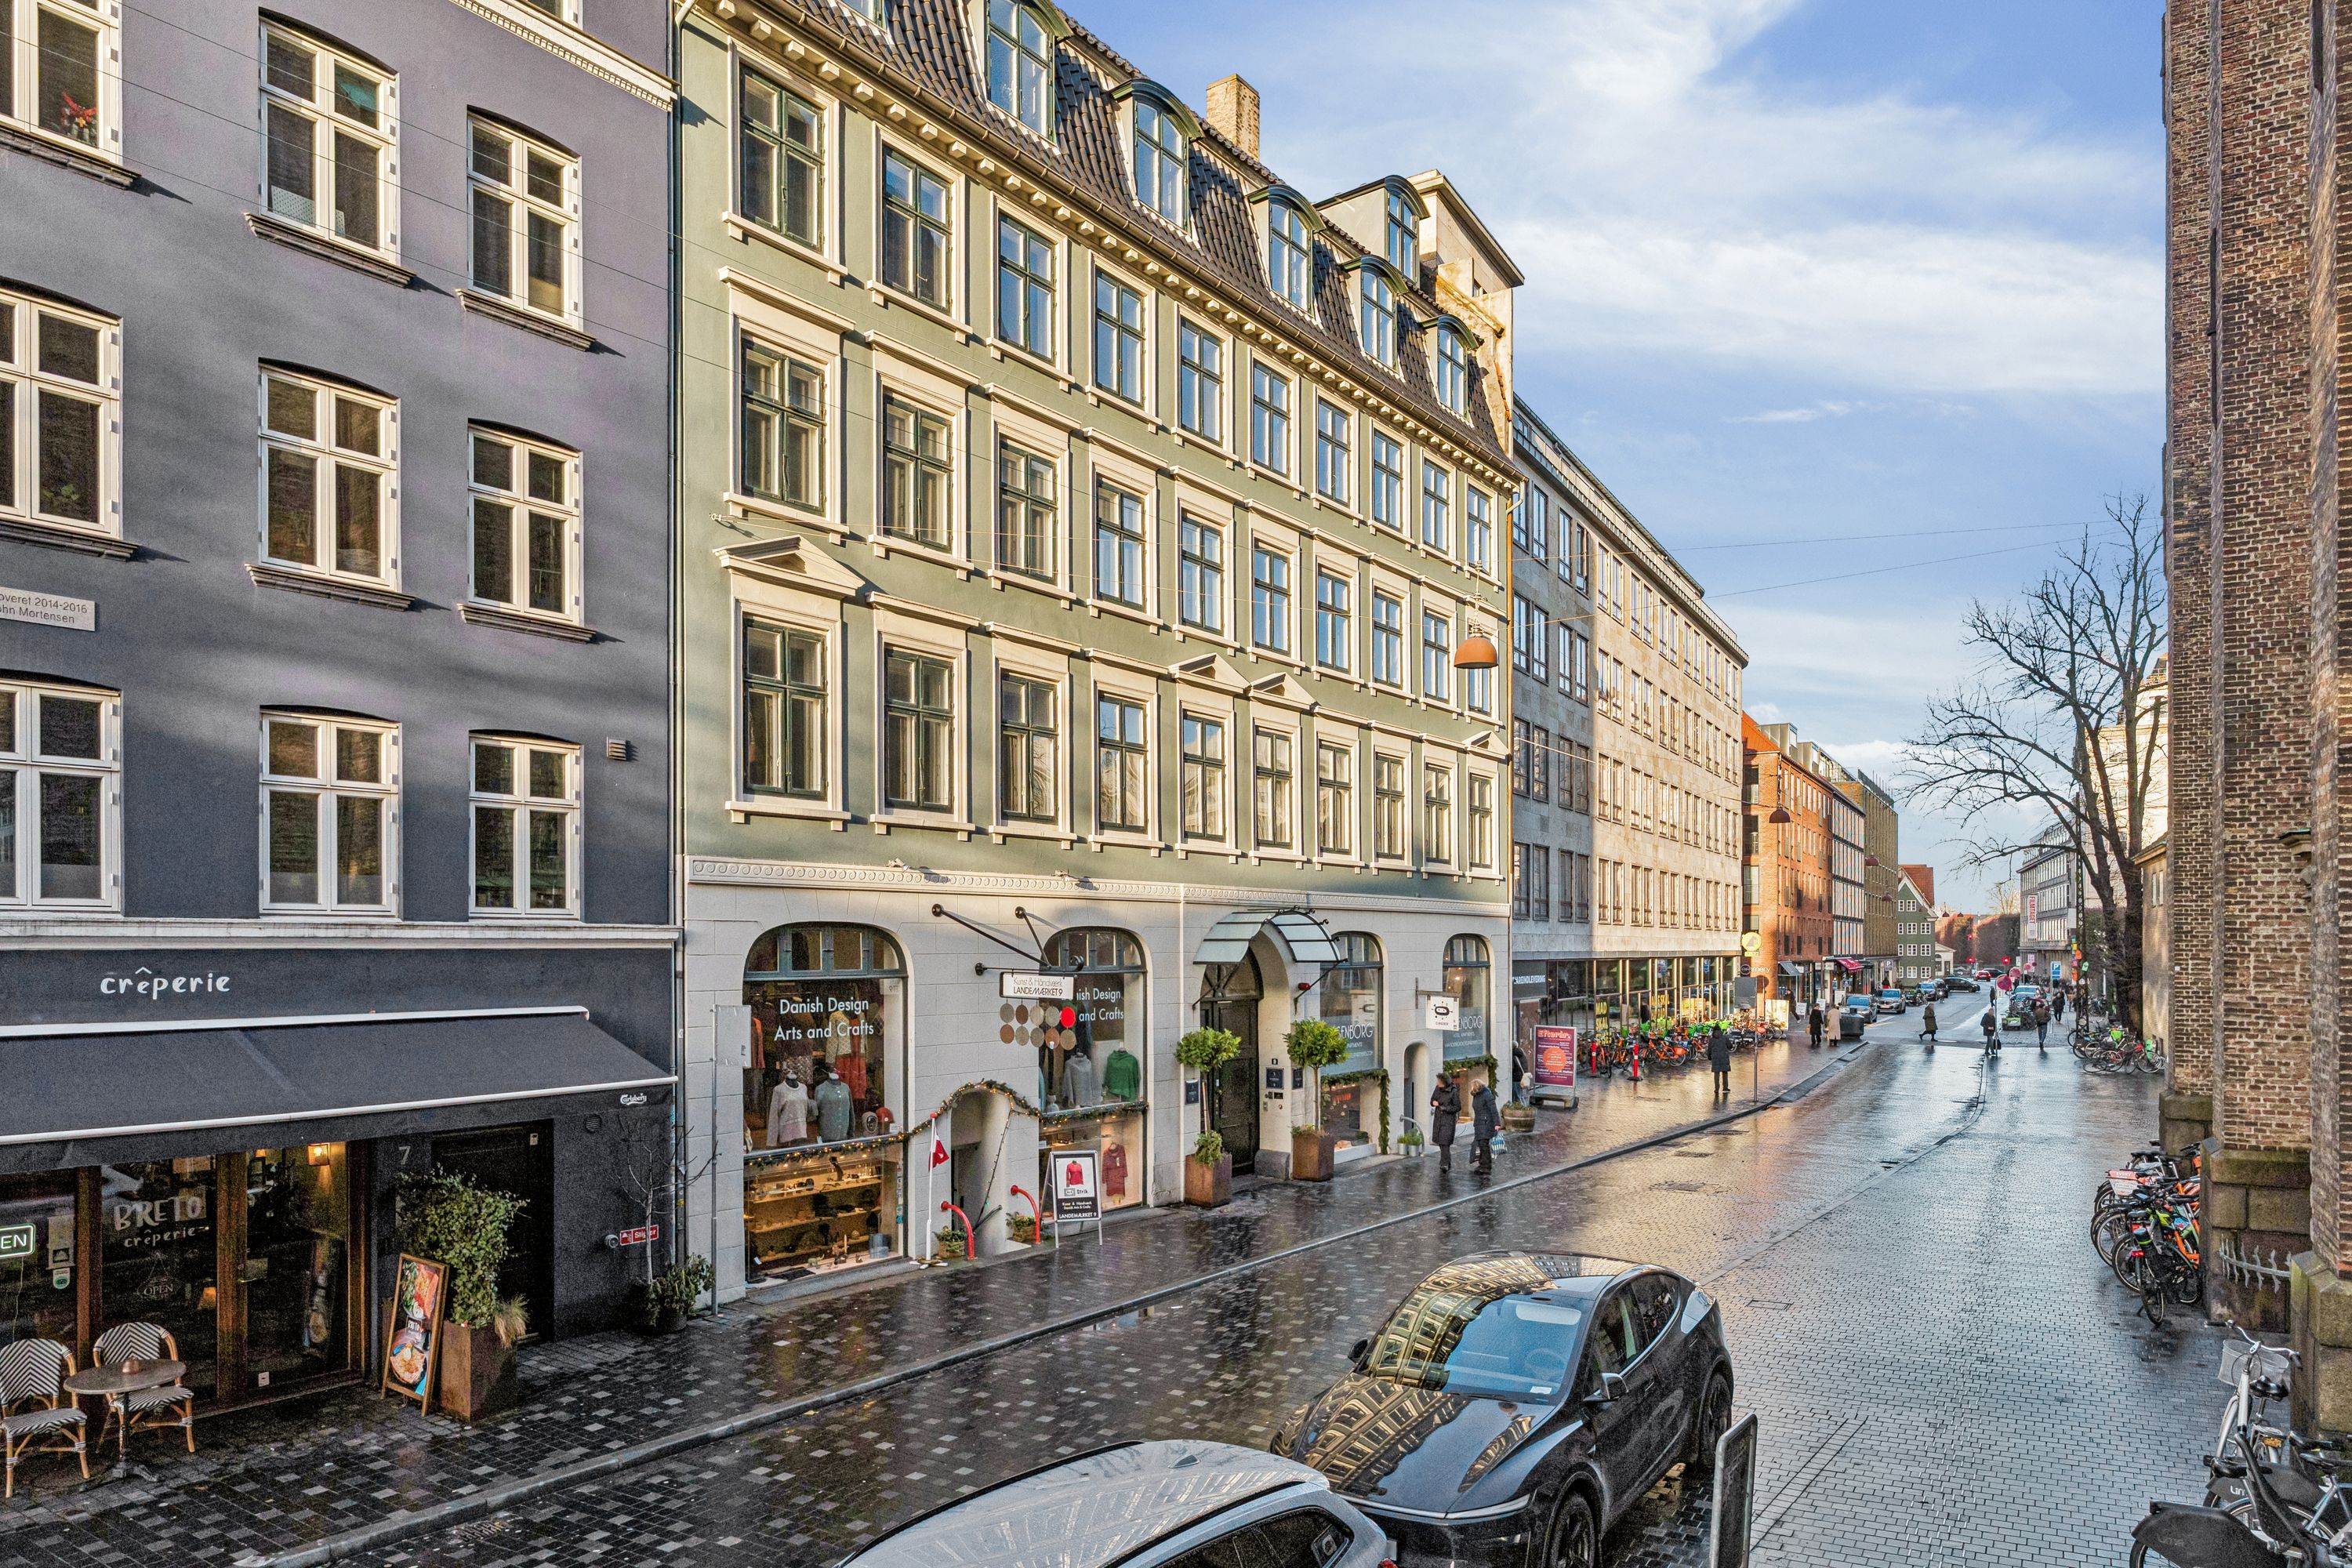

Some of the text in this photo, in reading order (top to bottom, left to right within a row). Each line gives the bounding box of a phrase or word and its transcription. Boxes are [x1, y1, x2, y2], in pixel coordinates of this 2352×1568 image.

[0, 604, 75, 623] hn Mortensen
[34, 597, 88, 614] 2014-2016
[100, 967, 230, 1000] crêperie
[1013, 977, 1028, 985] Kunst
[1013, 986, 1058, 996] LANDEMÆRKET
[1093, 988, 1121, 1003] Design
[780, 996, 869, 1014] Danish Design
[1079, 1007, 1124, 1022] and Crafts
[774, 1019, 874, 1041] Arts and Crafts
[620, 1093, 647, 1105] Carlsberg
[398, 1146, 411, 1165] 7
[114, 1196, 202, 1231] BRETO
[124, 1226, 196, 1247] crêperie
[143, 1284, 174, 1296] OPEN
